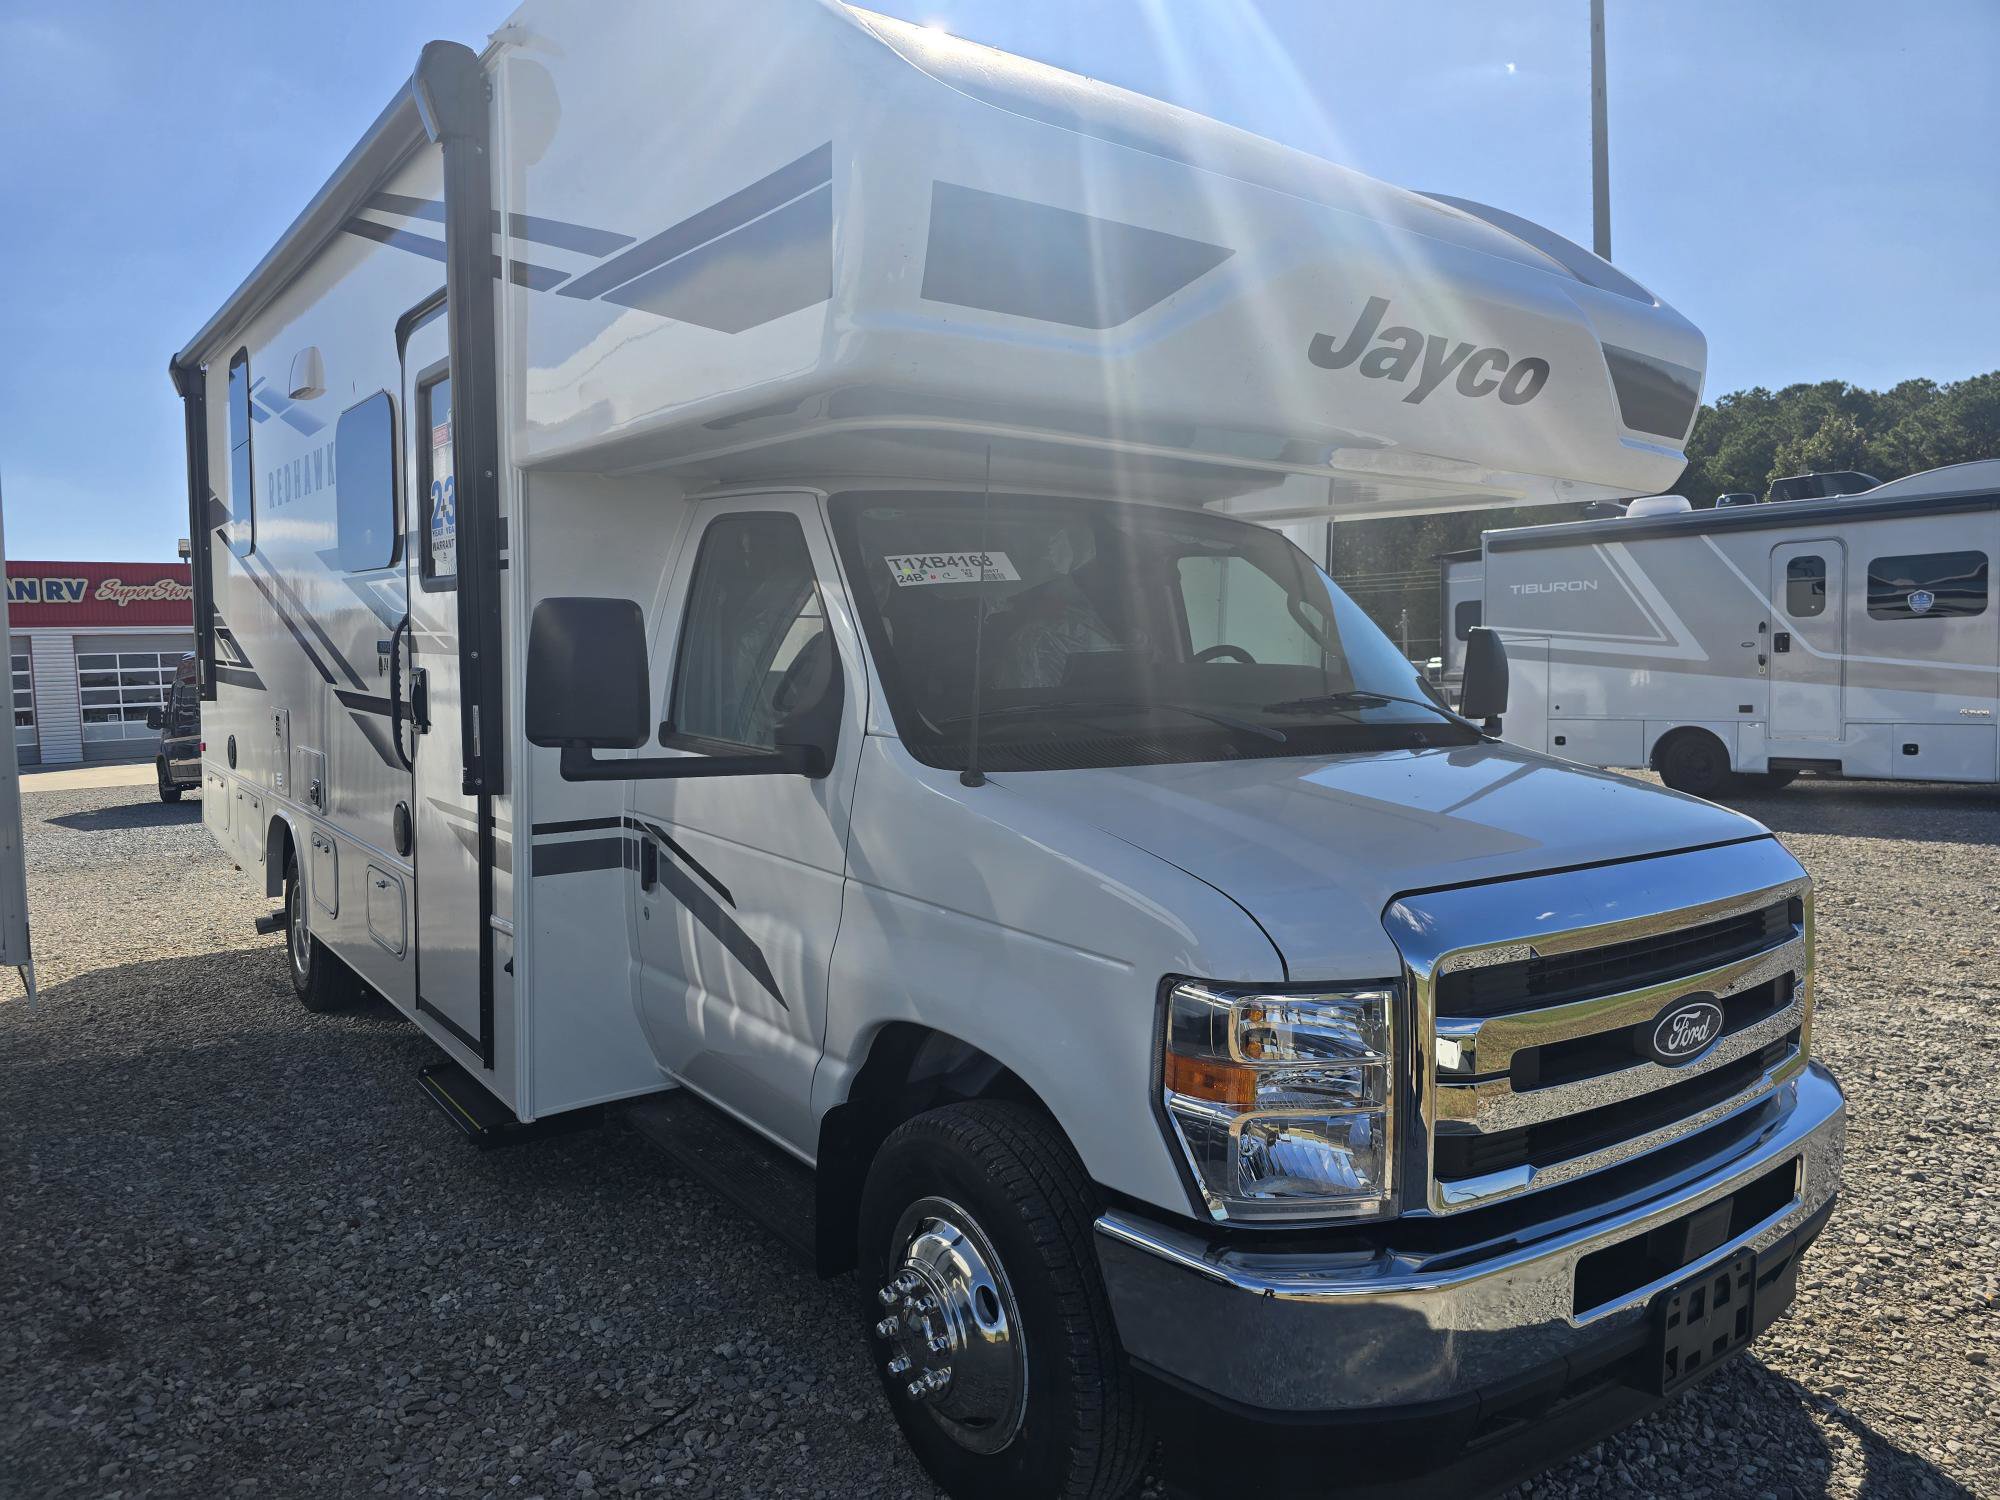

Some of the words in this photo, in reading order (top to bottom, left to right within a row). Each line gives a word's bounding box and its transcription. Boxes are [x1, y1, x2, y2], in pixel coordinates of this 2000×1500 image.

[1307, 295, 1551, 405] Jayco
[268, 441, 335, 510] REDHAWK
[433, 538, 455, 552] WARRANT
[888, 555, 994, 571] T1XB4168
[897, 573, 925, 583] 24B
[1509, 580, 1598, 595] TIBURON
[46, 580, 86, 600] RV
[97, 581, 193, 604] SuperStor
[1668, 1010, 1711, 1050] Ford
